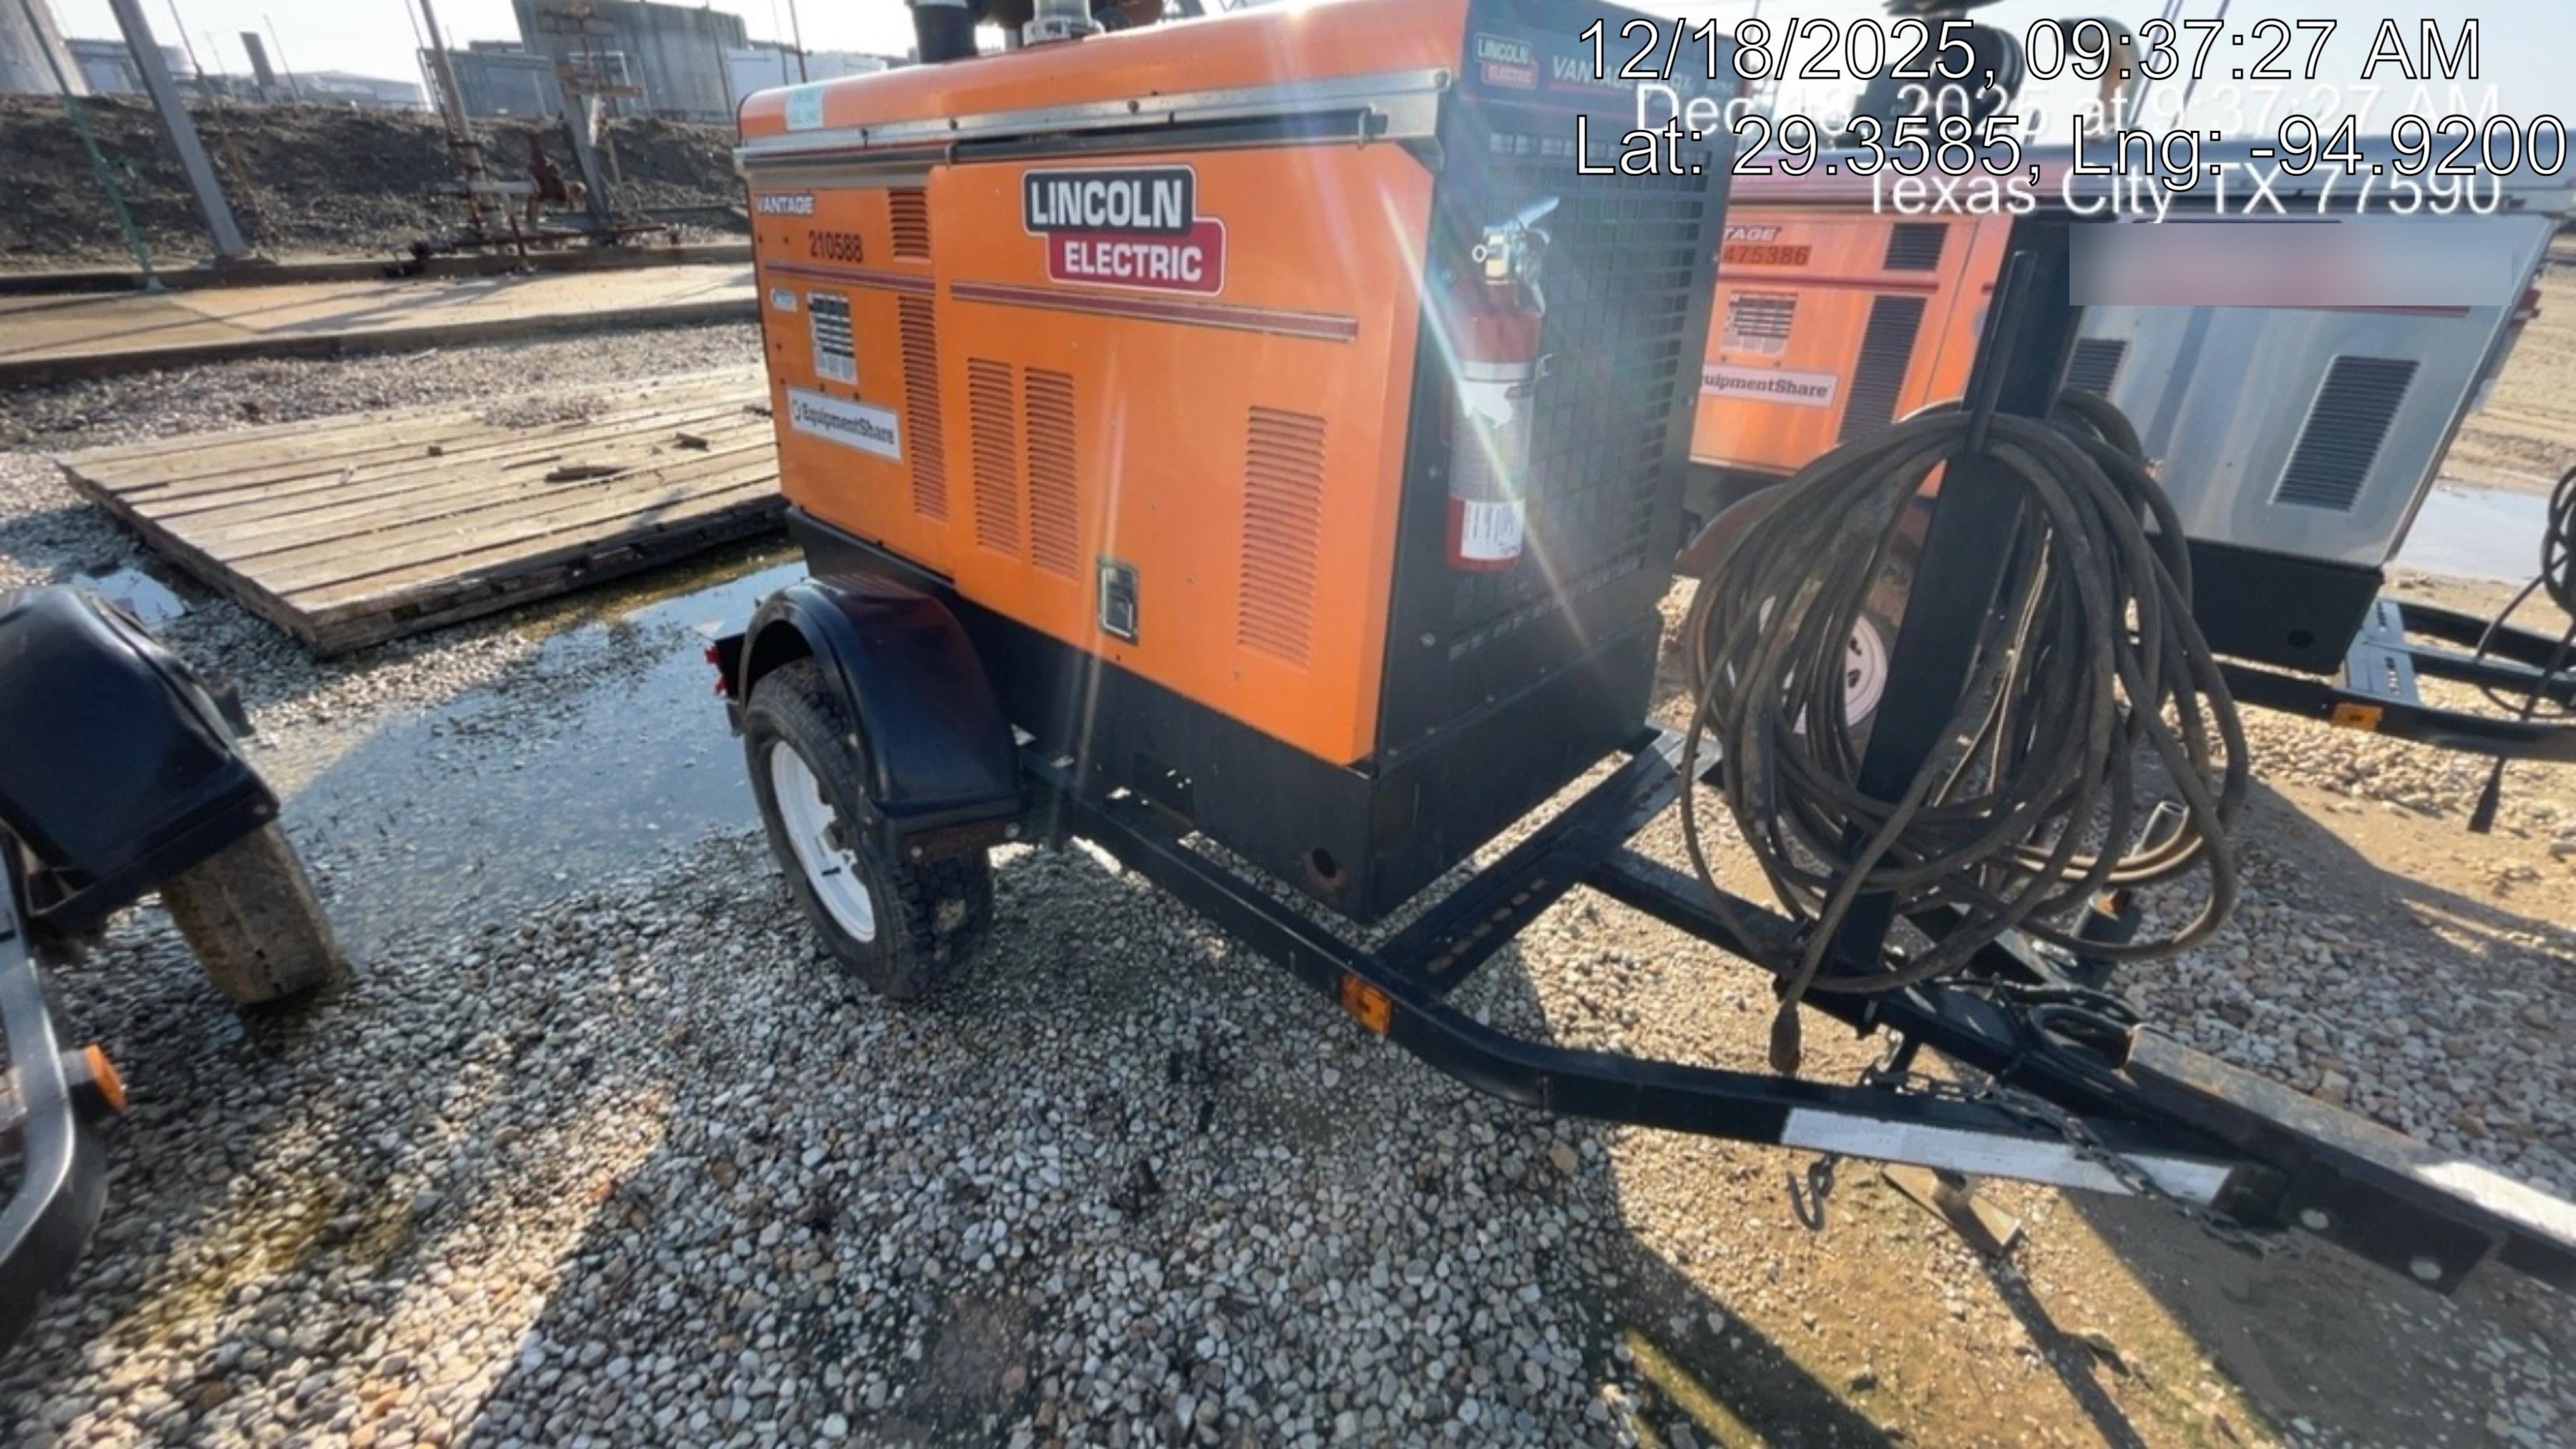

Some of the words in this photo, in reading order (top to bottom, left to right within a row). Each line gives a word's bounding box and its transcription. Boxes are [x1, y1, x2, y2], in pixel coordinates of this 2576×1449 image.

[756, 195, 815, 214] VANTAGE
[1031, 180, 1183, 228] LINCOLN
[808, 229, 864, 263] 210588
[1063, 240, 1204, 283] ELECTRIC
[802, 402, 894, 445] EquipmentShare
